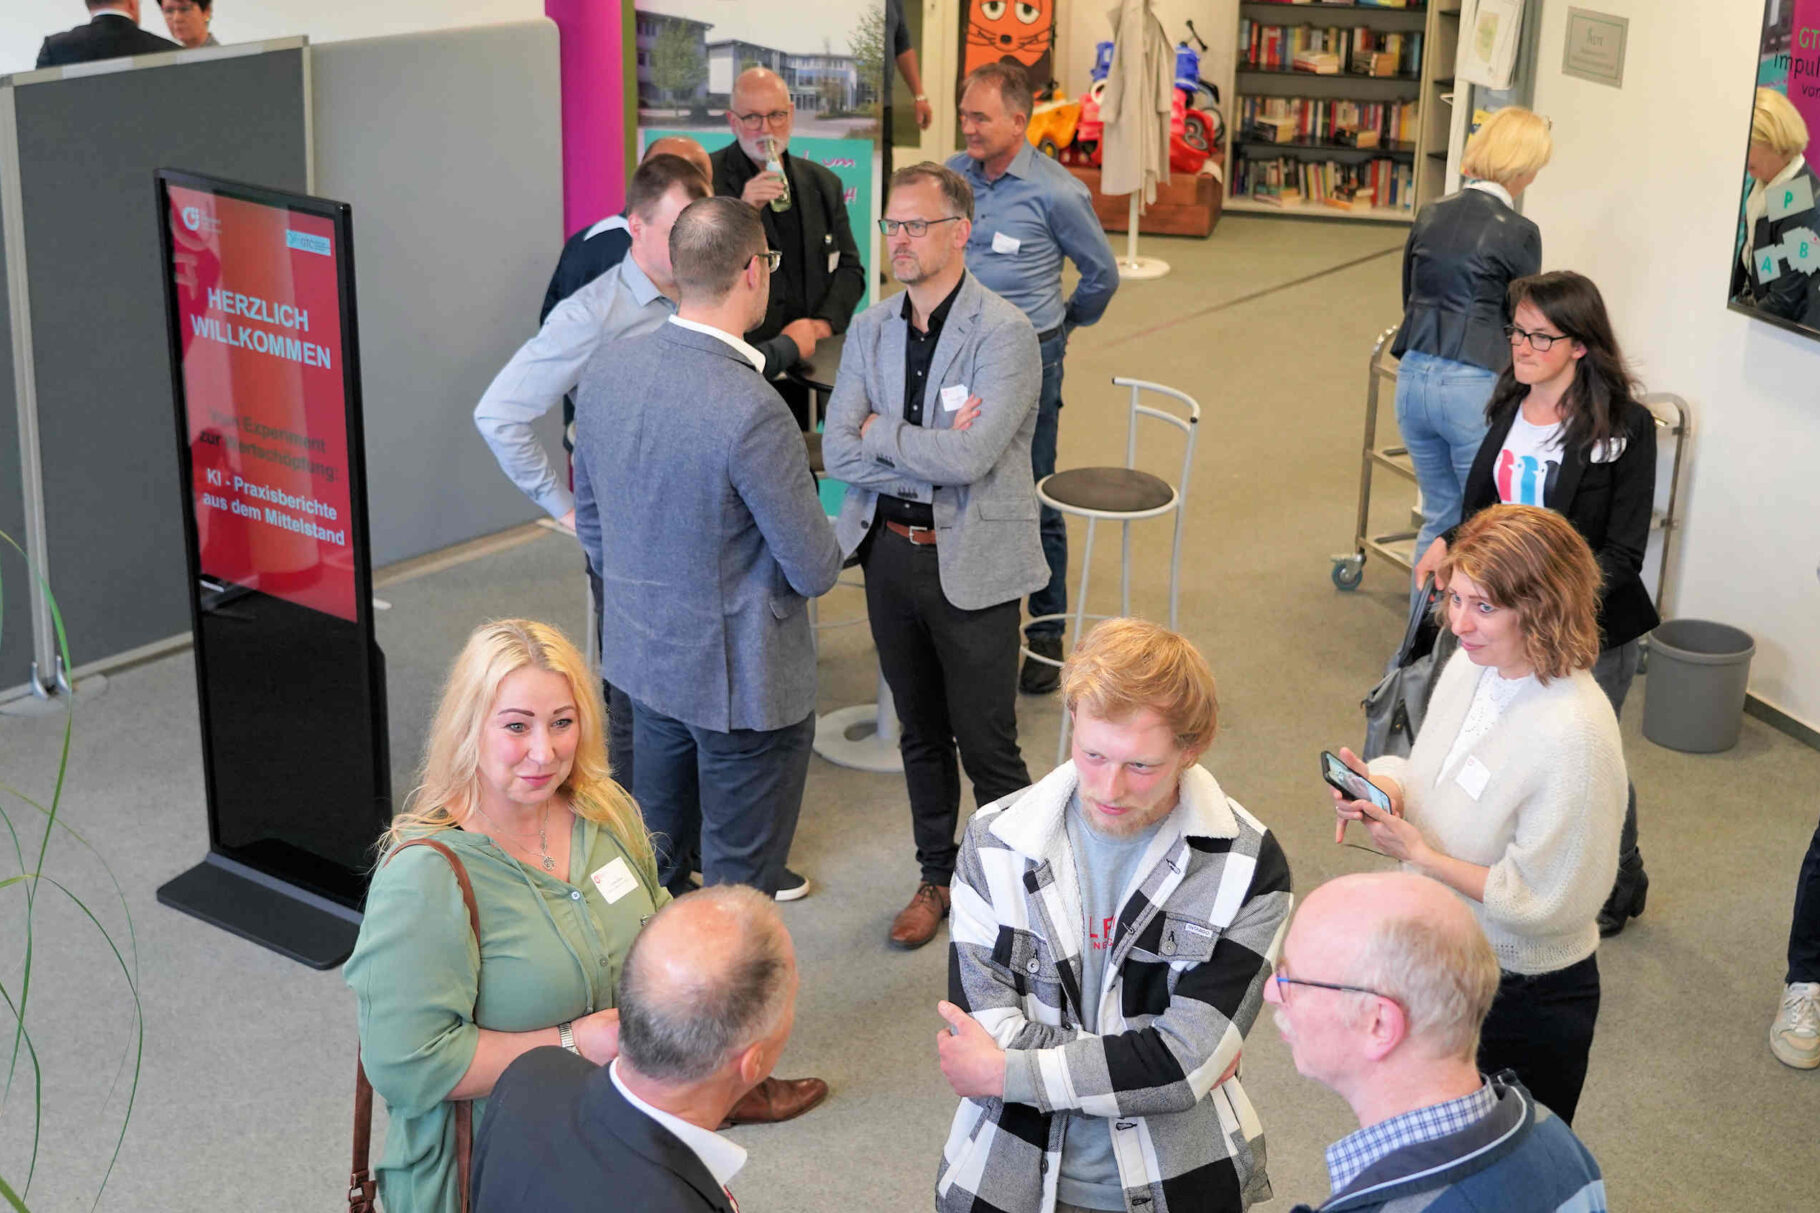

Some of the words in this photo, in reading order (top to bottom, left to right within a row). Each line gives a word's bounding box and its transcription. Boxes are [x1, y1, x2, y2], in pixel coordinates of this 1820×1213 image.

[1799, 26, 1820, 49] GT
[1783, 190, 1793, 209] P
[1799, 241, 1808, 259] B
[1761, 255, 1773, 275] A
[207, 287, 309, 332] HERZLICH
[190, 313, 331, 369] WILLKOMMEN
[200, 430, 222, 446] zur
[206, 467, 222, 486] KI
[233, 475, 337, 521] Praxisberichte
[202, 491, 228, 511] aus
[231, 499, 262, 521] dem
[265, 507, 345, 547] Mittelstand
